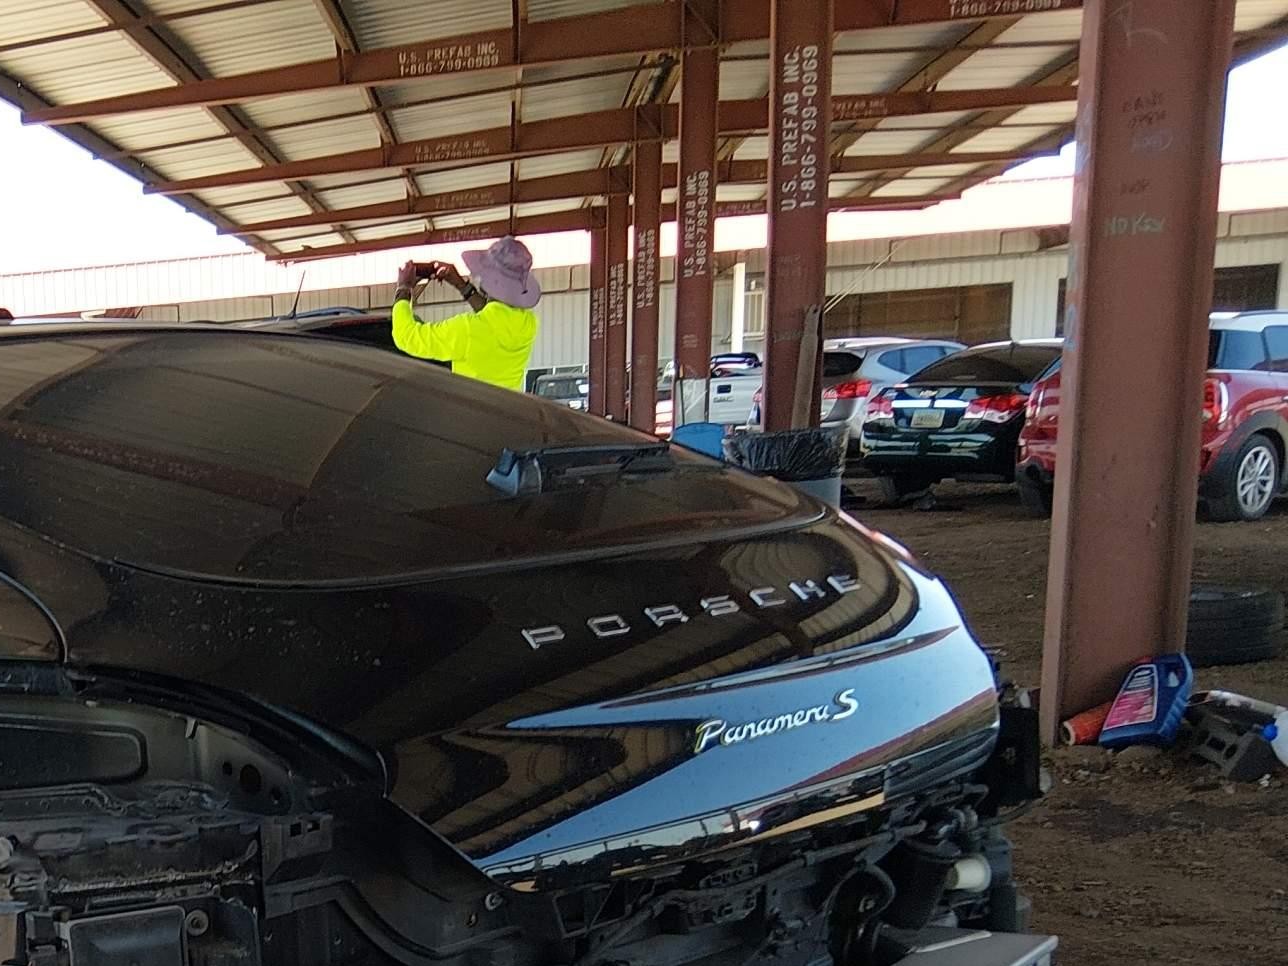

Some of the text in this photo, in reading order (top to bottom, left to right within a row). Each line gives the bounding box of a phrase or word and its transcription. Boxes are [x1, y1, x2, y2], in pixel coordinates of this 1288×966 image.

[781, 45, 800, 211] U.S. PREFAB INC.
[800, 45, 818, 208] 1-866-799-0969
[684, 200, 697, 249] PREFAB
[521, 574, 862, 650] PORSCHE
[693, 688, 860, 753] Panamera S
